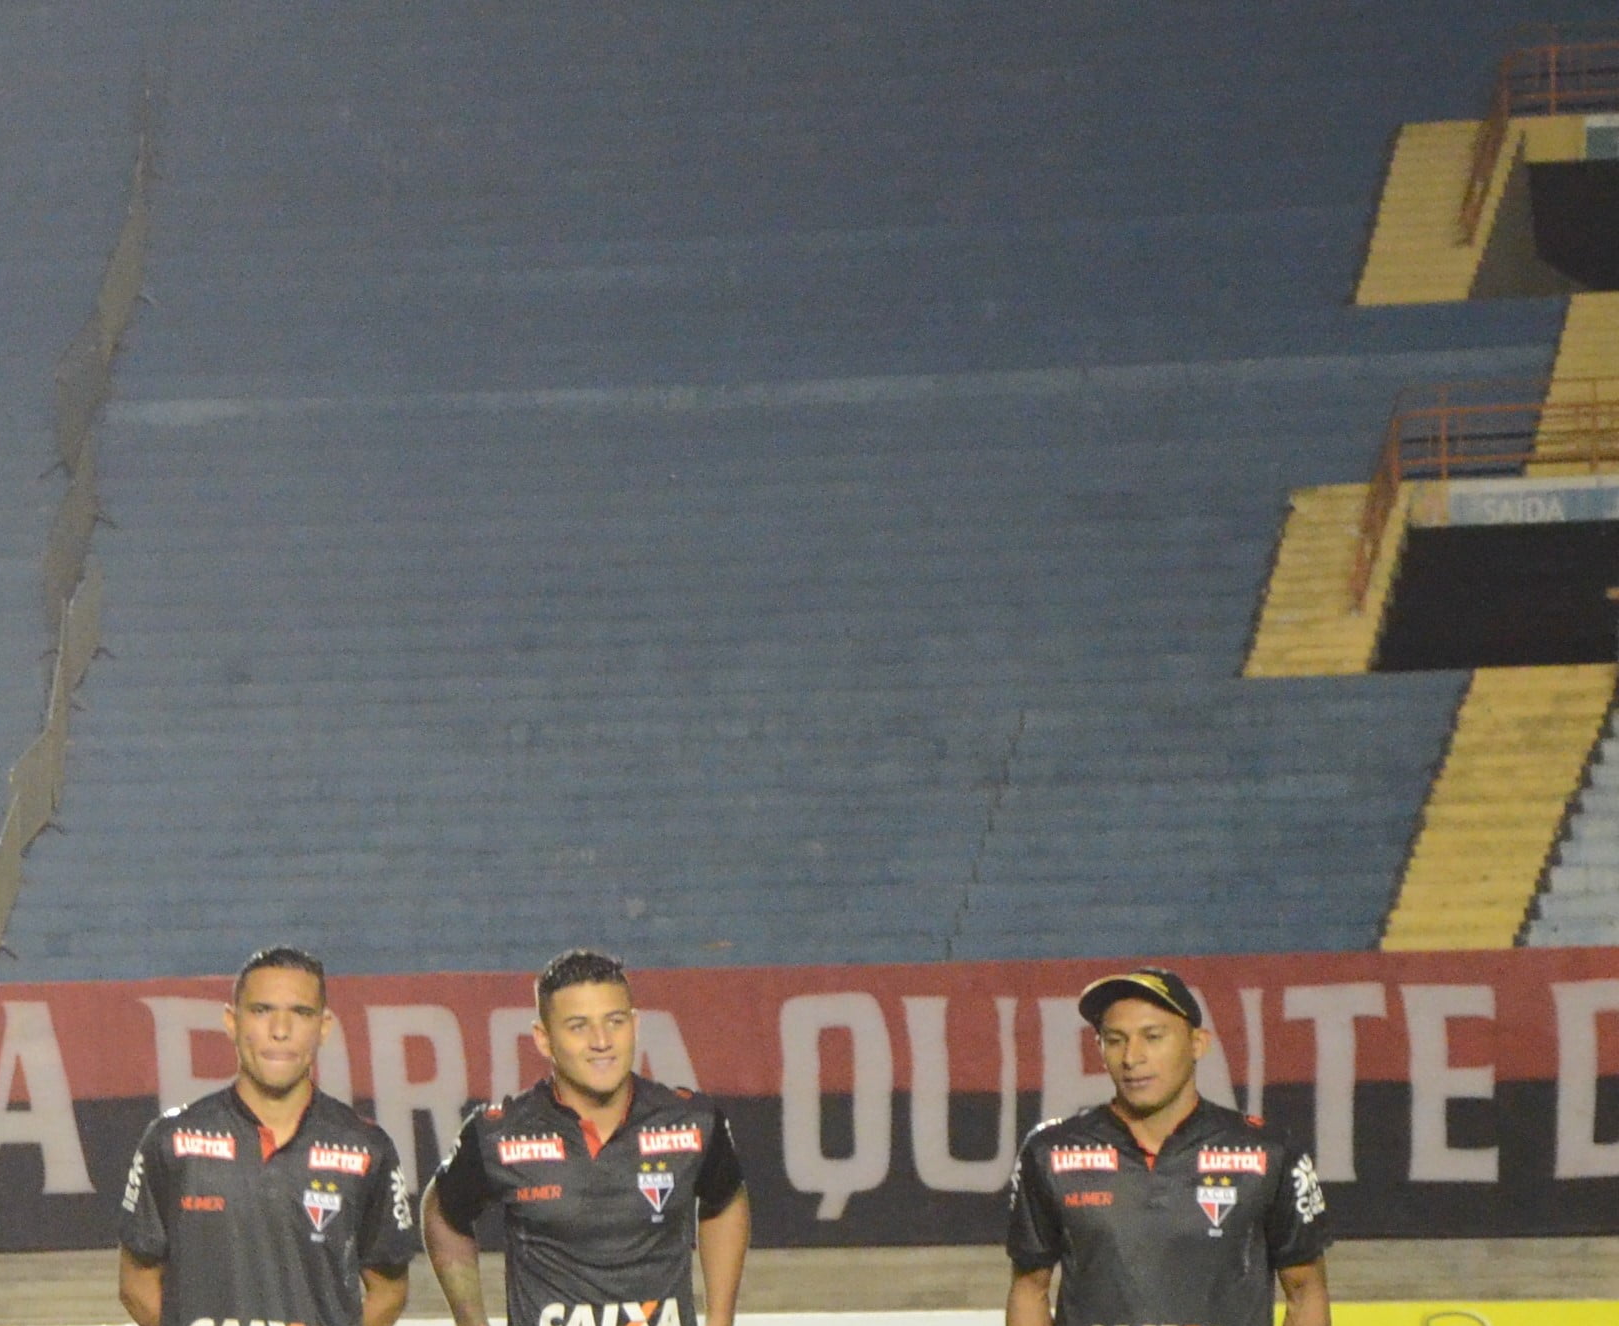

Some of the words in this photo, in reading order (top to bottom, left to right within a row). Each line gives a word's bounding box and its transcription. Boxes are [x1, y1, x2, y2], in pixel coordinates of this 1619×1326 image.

[175, 1134, 234, 1160] LUZTOL
[499, 1140, 564, 1163] LUZTOL
[640, 1131, 701, 1153] LUZTOL
[1052, 1151, 1116, 1172] LUZTOL
[1199, 1152, 1264, 1175] LUZTOL
